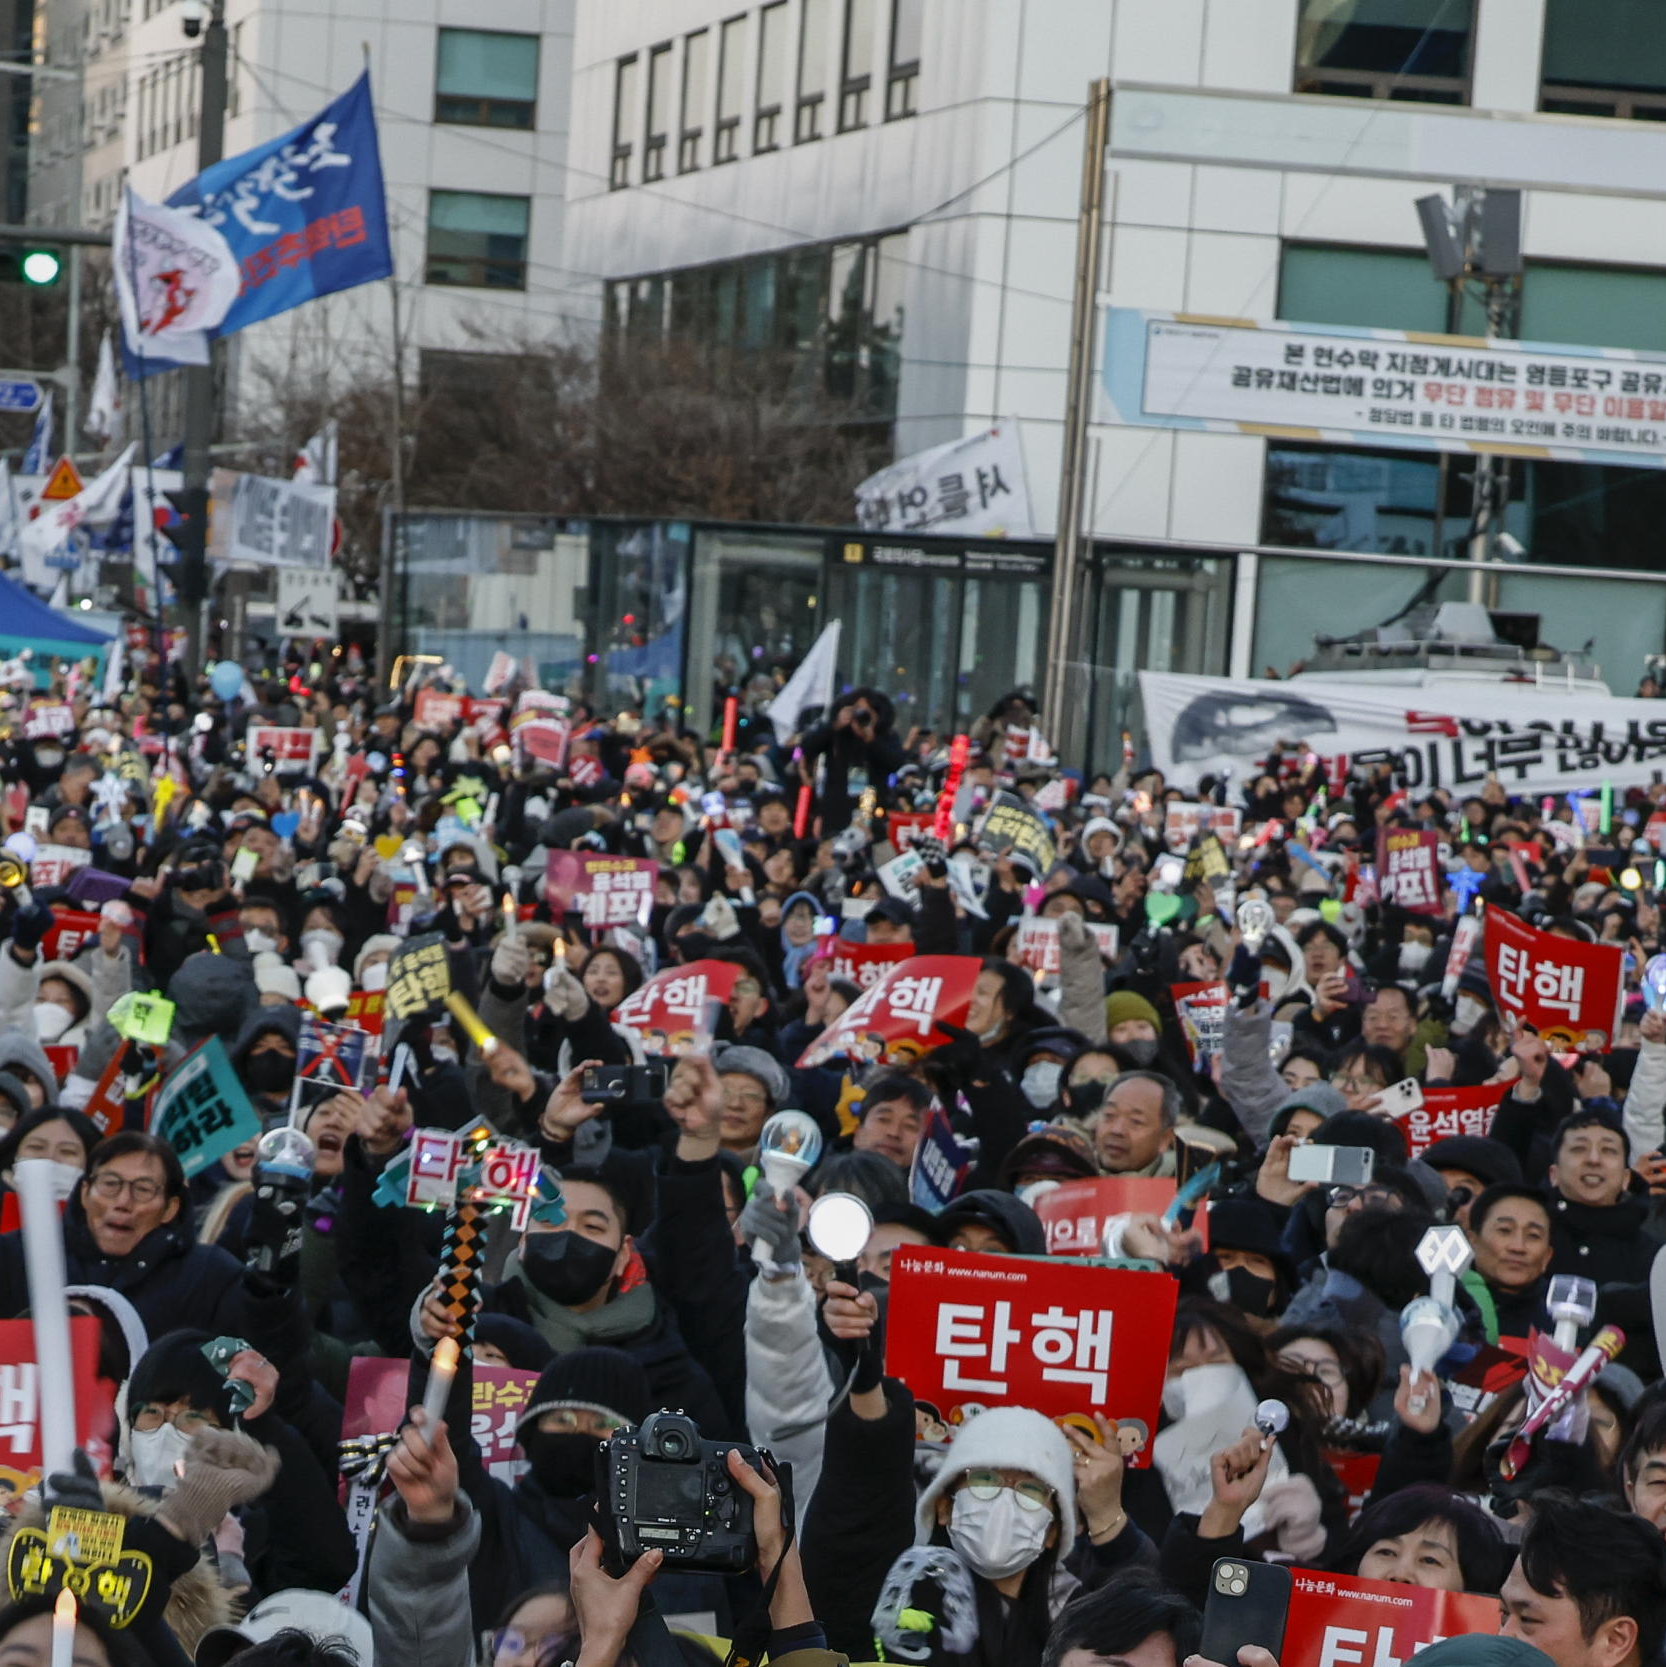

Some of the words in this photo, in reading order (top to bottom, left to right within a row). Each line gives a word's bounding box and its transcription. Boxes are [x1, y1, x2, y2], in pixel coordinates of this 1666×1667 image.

[1231, 365, 1365, 397] 공유재산법에
[1372, 377, 1415, 402] 의거
[1423, 381, 1466, 406] 무단
[1524, 389, 1545, 413] 및
[1553, 391, 1596, 417] 무단
[1284, 342, 1304, 366] 본
[1313, 345, 1379, 371] 현수막
[1525, 363, 1612, 391] 영등포구
[1452, 736, 1541, 784] 너무
[387, 967, 451, 1018] 탄핵
[617, 975, 710, 1027] 탄핵
[1497, 942, 1584, 1021] 탄핵
[407, 1134, 541, 1231] 탄핵
[899, 1258, 945, 1275] 나눔문화
[946, 1265, 1027, 1282] www.nanum.com
[934, 1300, 1113, 1405] 탄핵
[1294, 1577, 1336, 1595] 나눔문화
[1336, 1588, 1414, 1608] www.nanum.com
